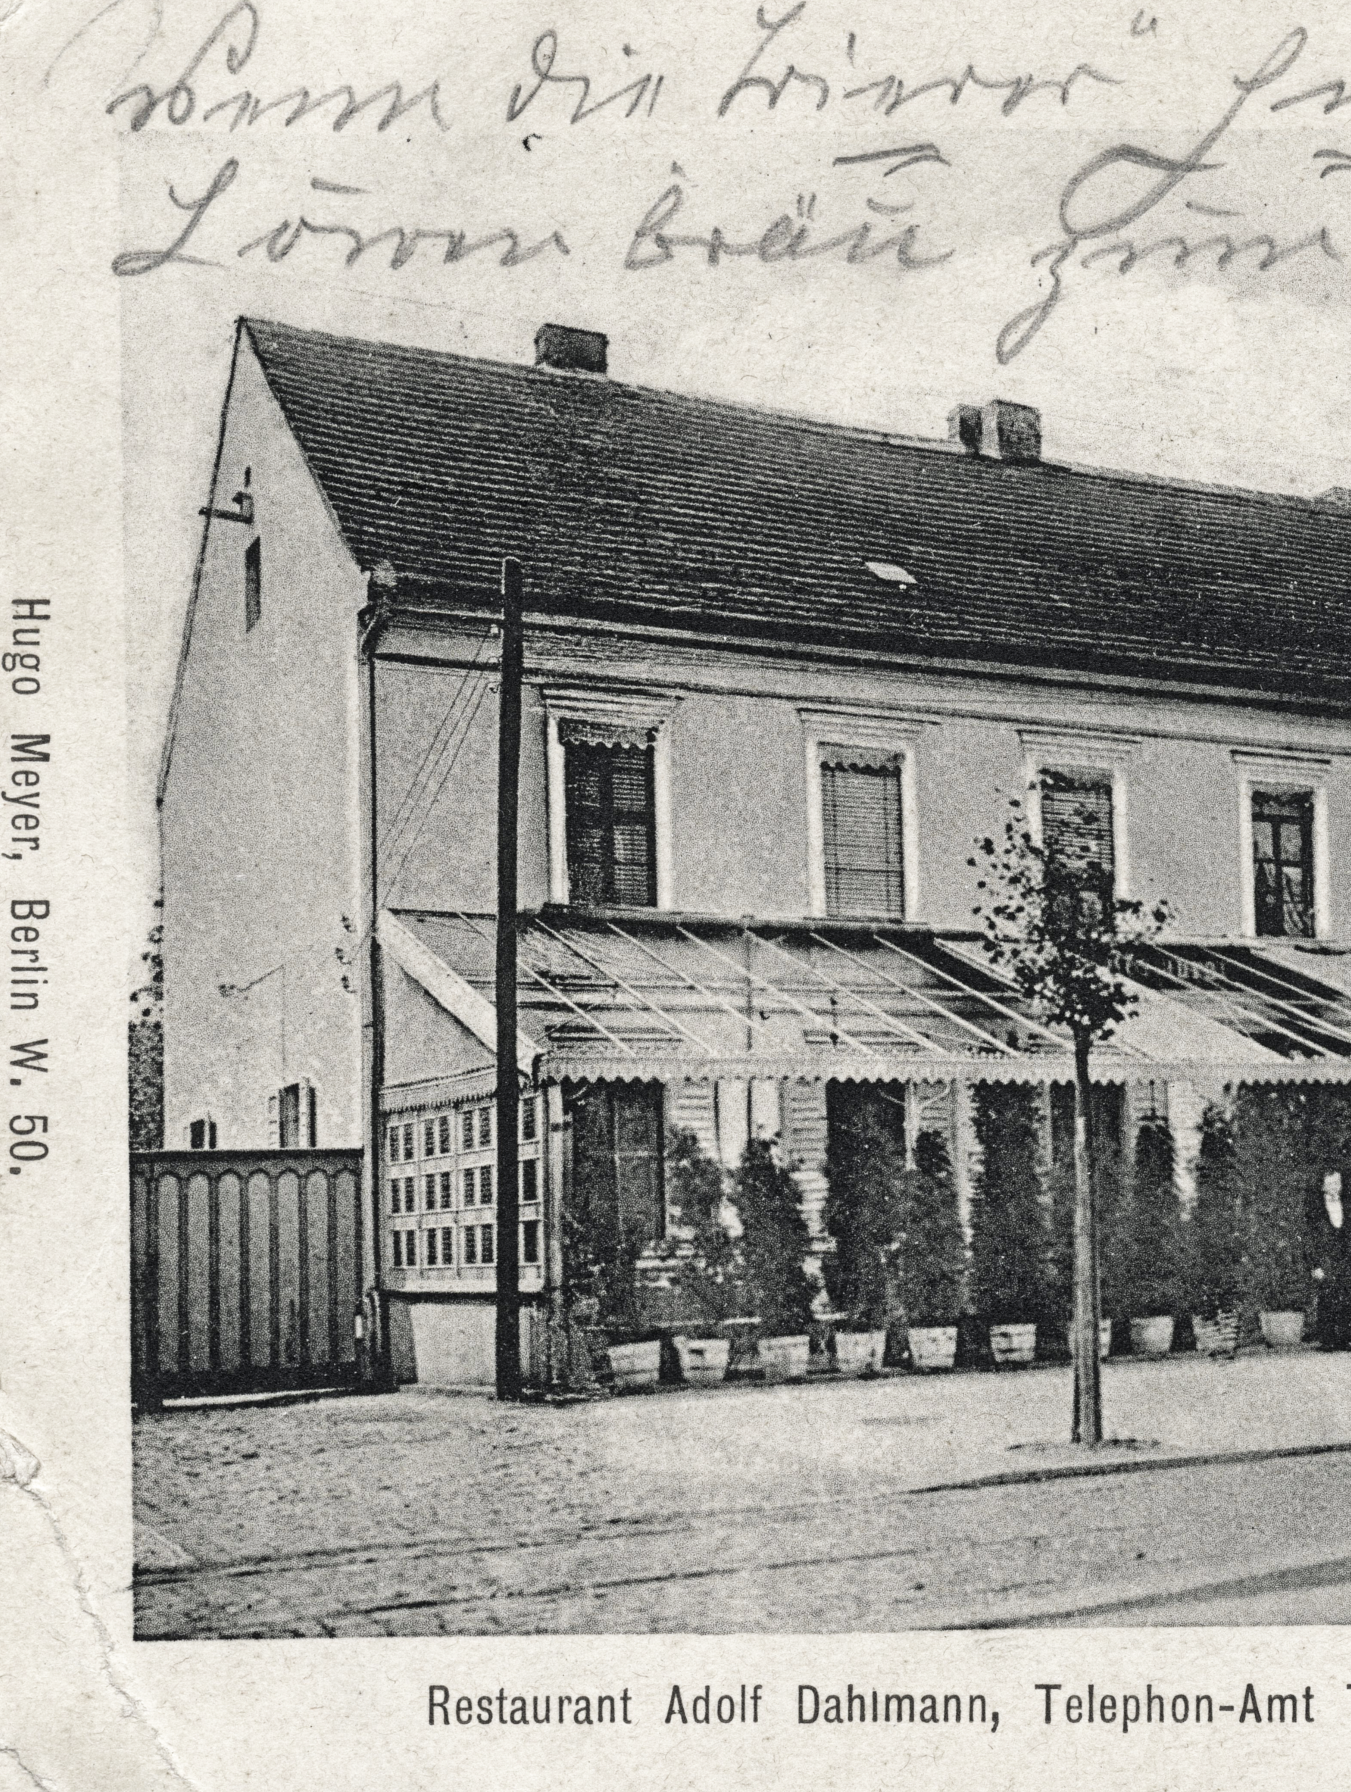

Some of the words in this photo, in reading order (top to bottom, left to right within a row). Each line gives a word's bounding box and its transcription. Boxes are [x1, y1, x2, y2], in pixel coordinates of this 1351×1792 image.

[2, 598, 52, 697] Hugo
[2, 734, 52, 862] Meyer,
[11, 899, 51, 1012] Berlin
[10, 1038, 50, 1088] W.
[10, 1115, 50, 1177] 50.
[429, 1685, 634, 1727] Restaurant
[665, 1685, 763, 1726] Adolf
[799, 1685, 1000, 1734] Dahlmann,
[1035, 1684, 1316, 1735] Telephon-Amt
